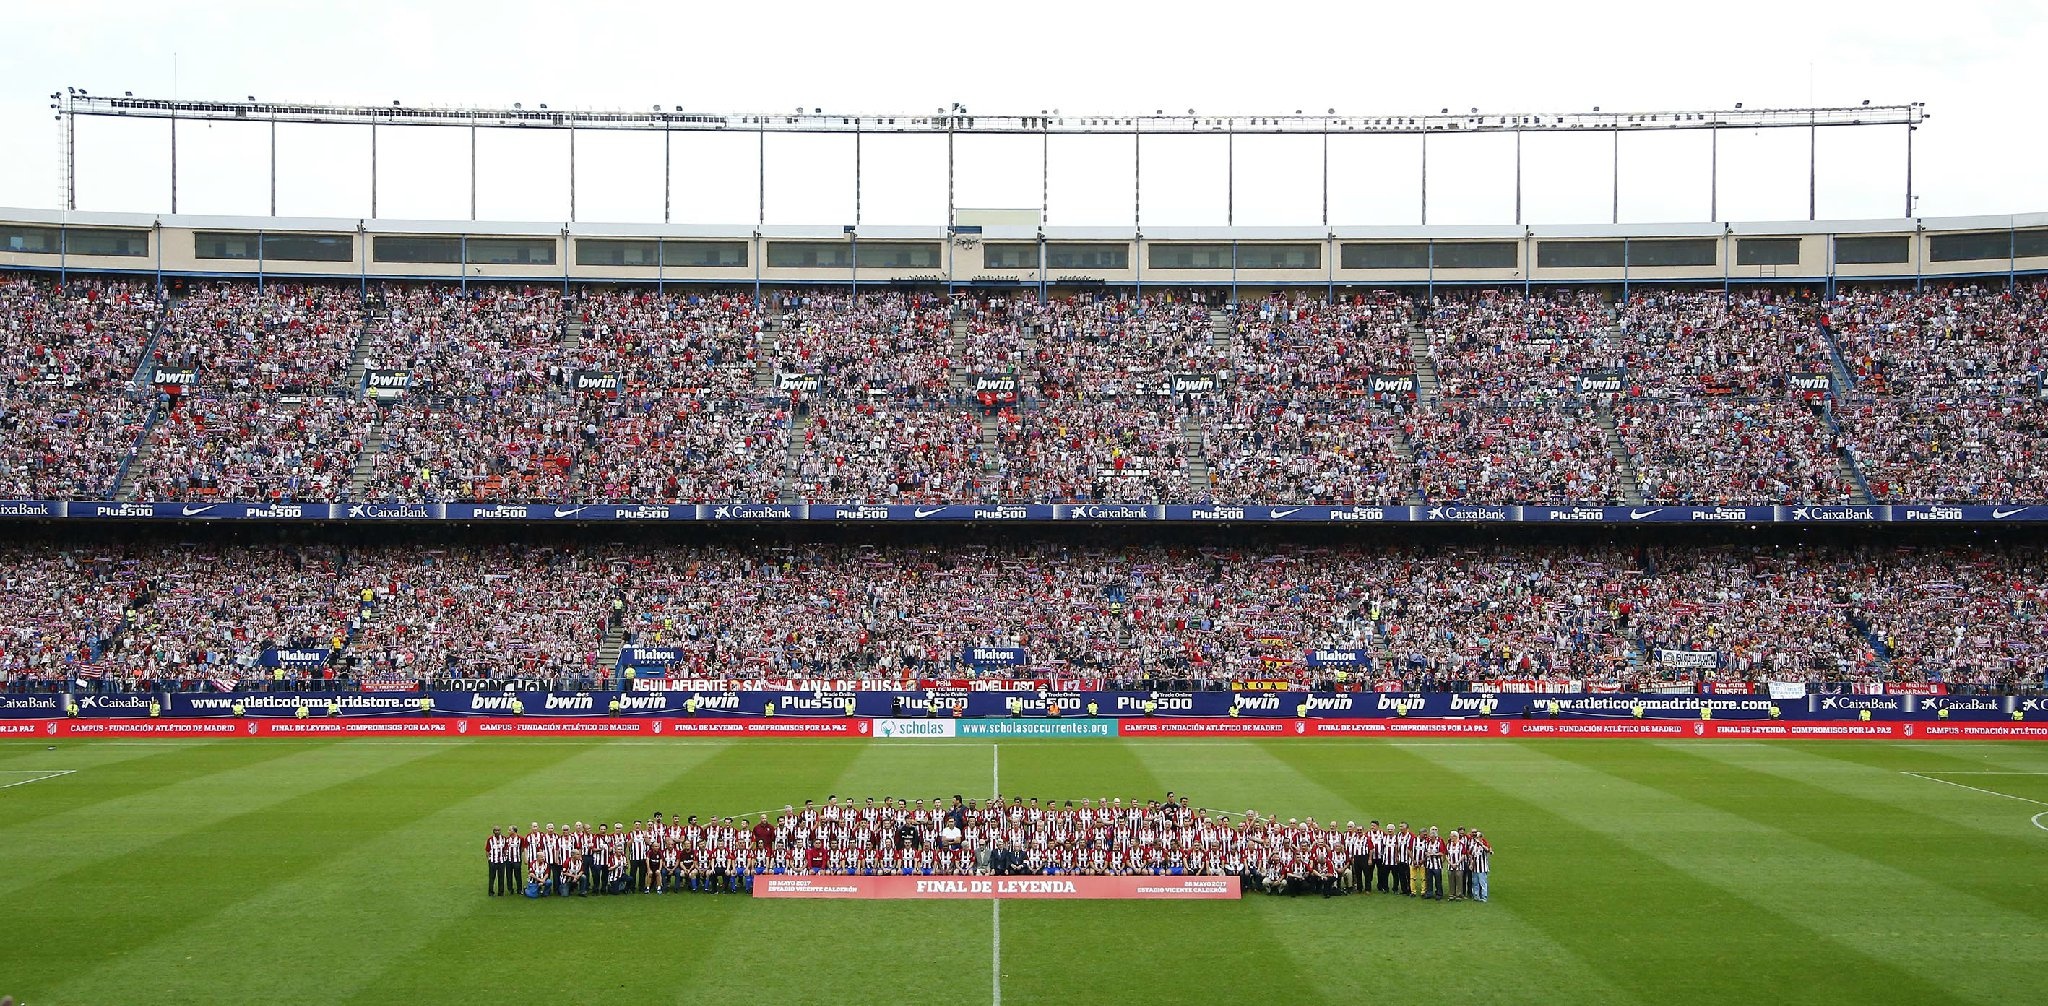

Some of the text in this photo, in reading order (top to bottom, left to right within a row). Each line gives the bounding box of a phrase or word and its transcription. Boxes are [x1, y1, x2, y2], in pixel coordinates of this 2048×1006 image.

[155, 370, 194, 384] bwin
[369, 373, 407, 386] bwin
[578, 377, 616, 388] bwin
[977, 377, 1014, 390] bwin
[1175, 378, 1213, 391] bwin
[1374, 378, 1412, 391] bwin
[1583, 377, 1620, 390] bwin
[97, 506, 153, 517] Plus500
[246, 506, 301, 517] Plus500
[366, 505, 428, 518] CaixaBank
[473, 507, 527, 518] Plus500
[615, 508, 669, 519] Plus500
[732, 506, 791, 518] CaixaBank
[836, 508, 888, 519] Plus500
[974, 508, 1027, 519] Plus500
[1088, 506, 1147, 518] CaixaBank
[1192, 508, 1244, 519] Plus500
[1330, 509, 1383, 520] Plus500
[1446, 507, 1505, 519] CaixaBank
[1550, 510, 1603, 520] Plus500
[1692, 510, 1746, 520] Plus500
[1811, 507, 1873, 520] CaixaBank
[1906, 509, 1962, 520] Plus500
[277, 649, 320, 660] Mahou
[633, 648, 675, 660] Mahou
[973, 648, 1014, 660] Mahou
[1315, 650, 1356, 661] Mahou
[632, 679, 727, 691] AGUILAFUENTE
[836, 680, 857, 691] DE
[862, 680, 902, 691] PUSA
[968, 681, 1035, 692] TOMELLOSO
[545, 692, 593, 709] bwin
[619, 692, 667, 709] bwin
[693, 692, 739, 709] bwin
[1234, 693, 1280, 709] bwin
[1305, 693, 1352, 710] bwin
[1377, 693, 1425, 710] bwin
[1450, 693, 1498, 710] bwin
[1838, 697, 1898, 710] CaixaBank
[1939, 698, 1998, 711] CaixaBank
[108, 723, 154, 731] FUNDACIÓN
[155, 723, 192, 731] ATLÉTICO
[517, 723, 560, 731] FUNDACIÓN
[561, 723, 597, 731] ATLÉTICO
[899, 720, 944, 734] scholas
[962, 721, 1108, 735] www.scholasoccurrentes.org
[1162, 723, 1204, 731] FUNDACIÓN
[1205, 723, 1241, 731] ATLÉTICO
[1559, 724, 1602, 732] FUNDACIÓN
[1603, 724, 1639, 732] ATLÉTICO
[1964, 725, 2008, 734] FUNDACIÓN
[2010, 725, 2048, 734] ATLÉTICO
[916, 880, 1077, 892] FINAL DE LEYENDA
